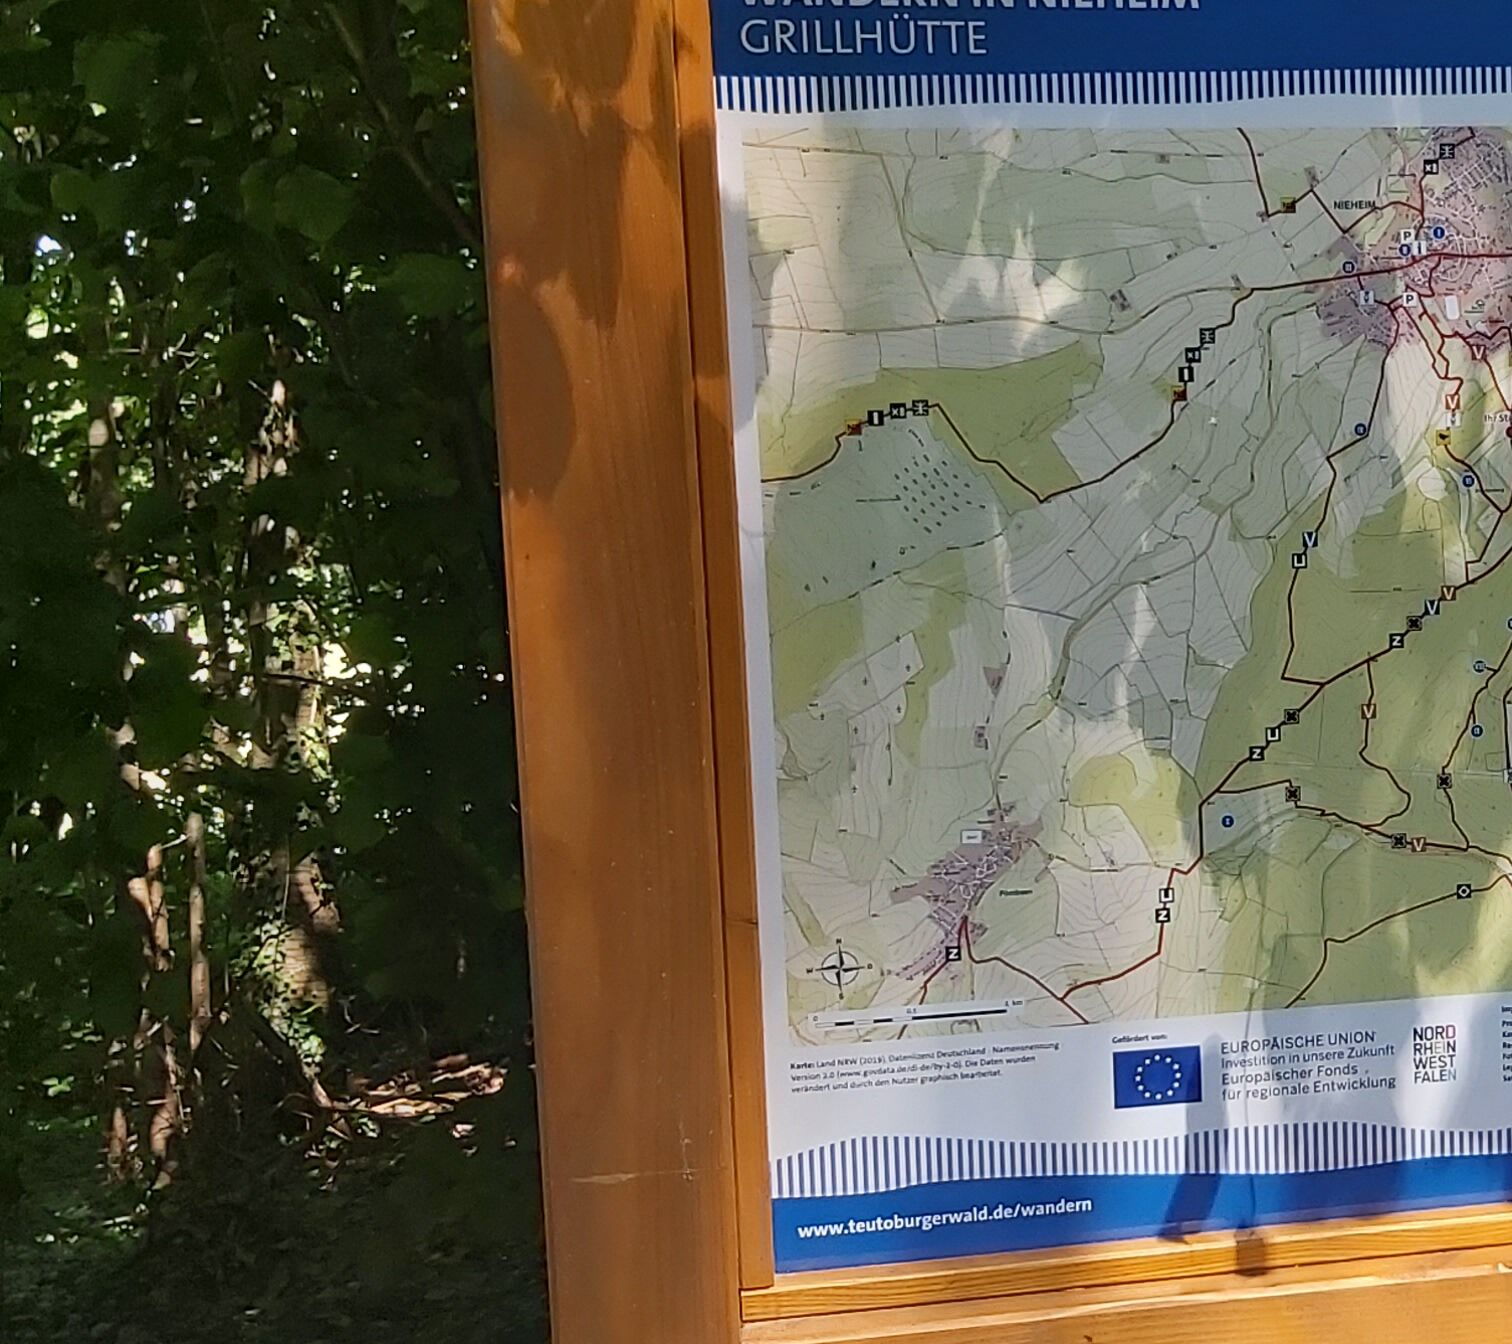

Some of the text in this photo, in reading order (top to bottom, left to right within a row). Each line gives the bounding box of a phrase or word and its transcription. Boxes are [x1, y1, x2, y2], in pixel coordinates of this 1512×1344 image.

[740, 14, 987, 54] GRILLHÜTTE
[1334, 200, 1376, 210] NIEHEIM
[1112, 1034, 1149, 1043] Gefördert
[1221, 1031, 1375, 1054] EUROPÄISCHE UNION
[1413, 1025, 1456, 1042] NORD
[1221, 1044, 1395, 1069] Investition in unsere Zukunft
[1413, 1040, 1456, 1055] RHEIN
[816, 1048, 986, 1067] Land NRW Deutschland
[965, 1058, 1003, 1068] Die Daten
[1413, 1055, 1455, 1069] WEST
[1222, 1064, 1358, 1085] Europäischer Fonds
[1414, 1068, 1456, 1084] FALEN
[791, 1075, 918, 1093] verändert und den Nutzer
[1222, 1076, 1396, 1101] für regionale Entwicklung
[798, 1198, 1092, 1238] www.teutoburgerwald.de/wandern
